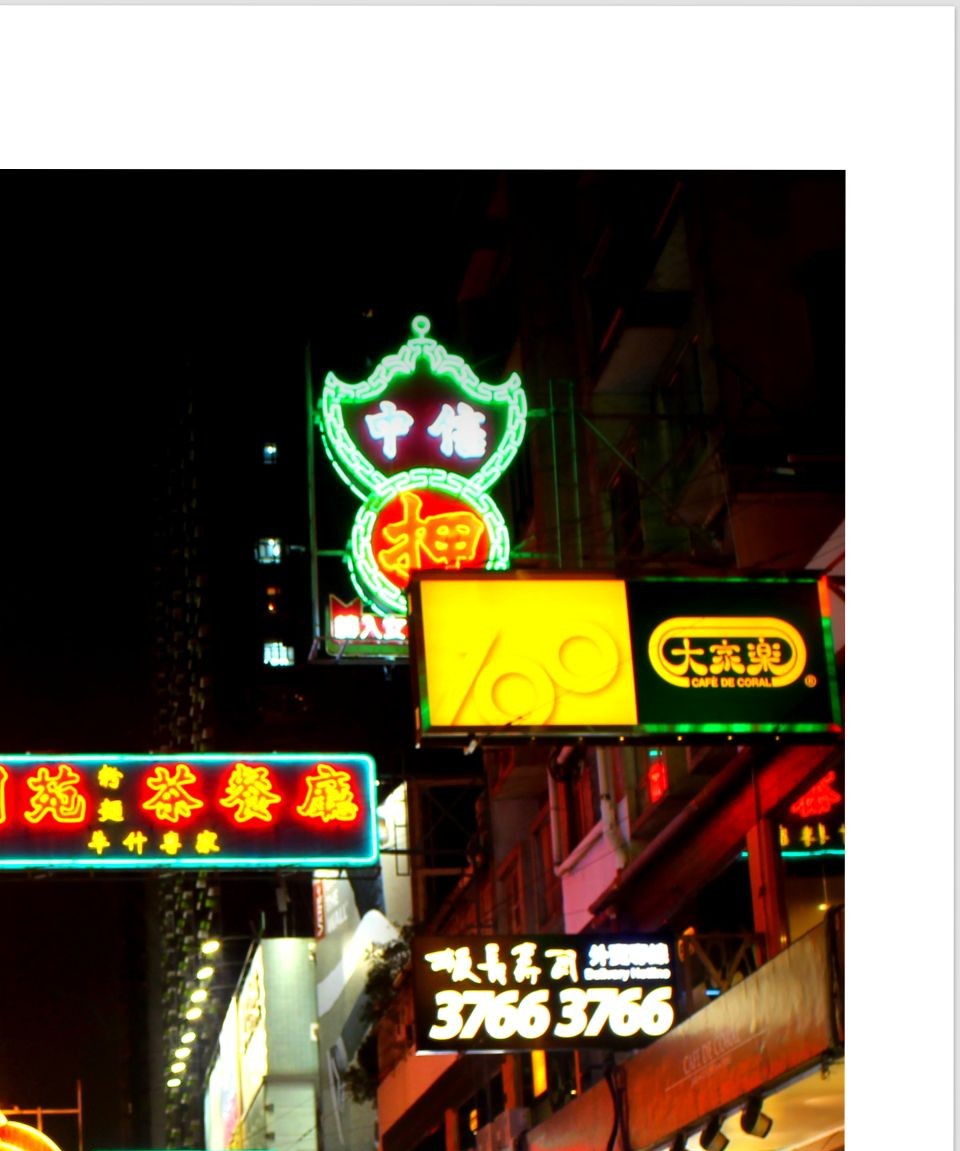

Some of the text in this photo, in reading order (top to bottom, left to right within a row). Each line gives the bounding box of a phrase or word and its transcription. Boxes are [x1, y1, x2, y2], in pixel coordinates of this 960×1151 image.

[720, 677, 736, 688] DE
[428, 986, 675, 1040] 3766 3766
